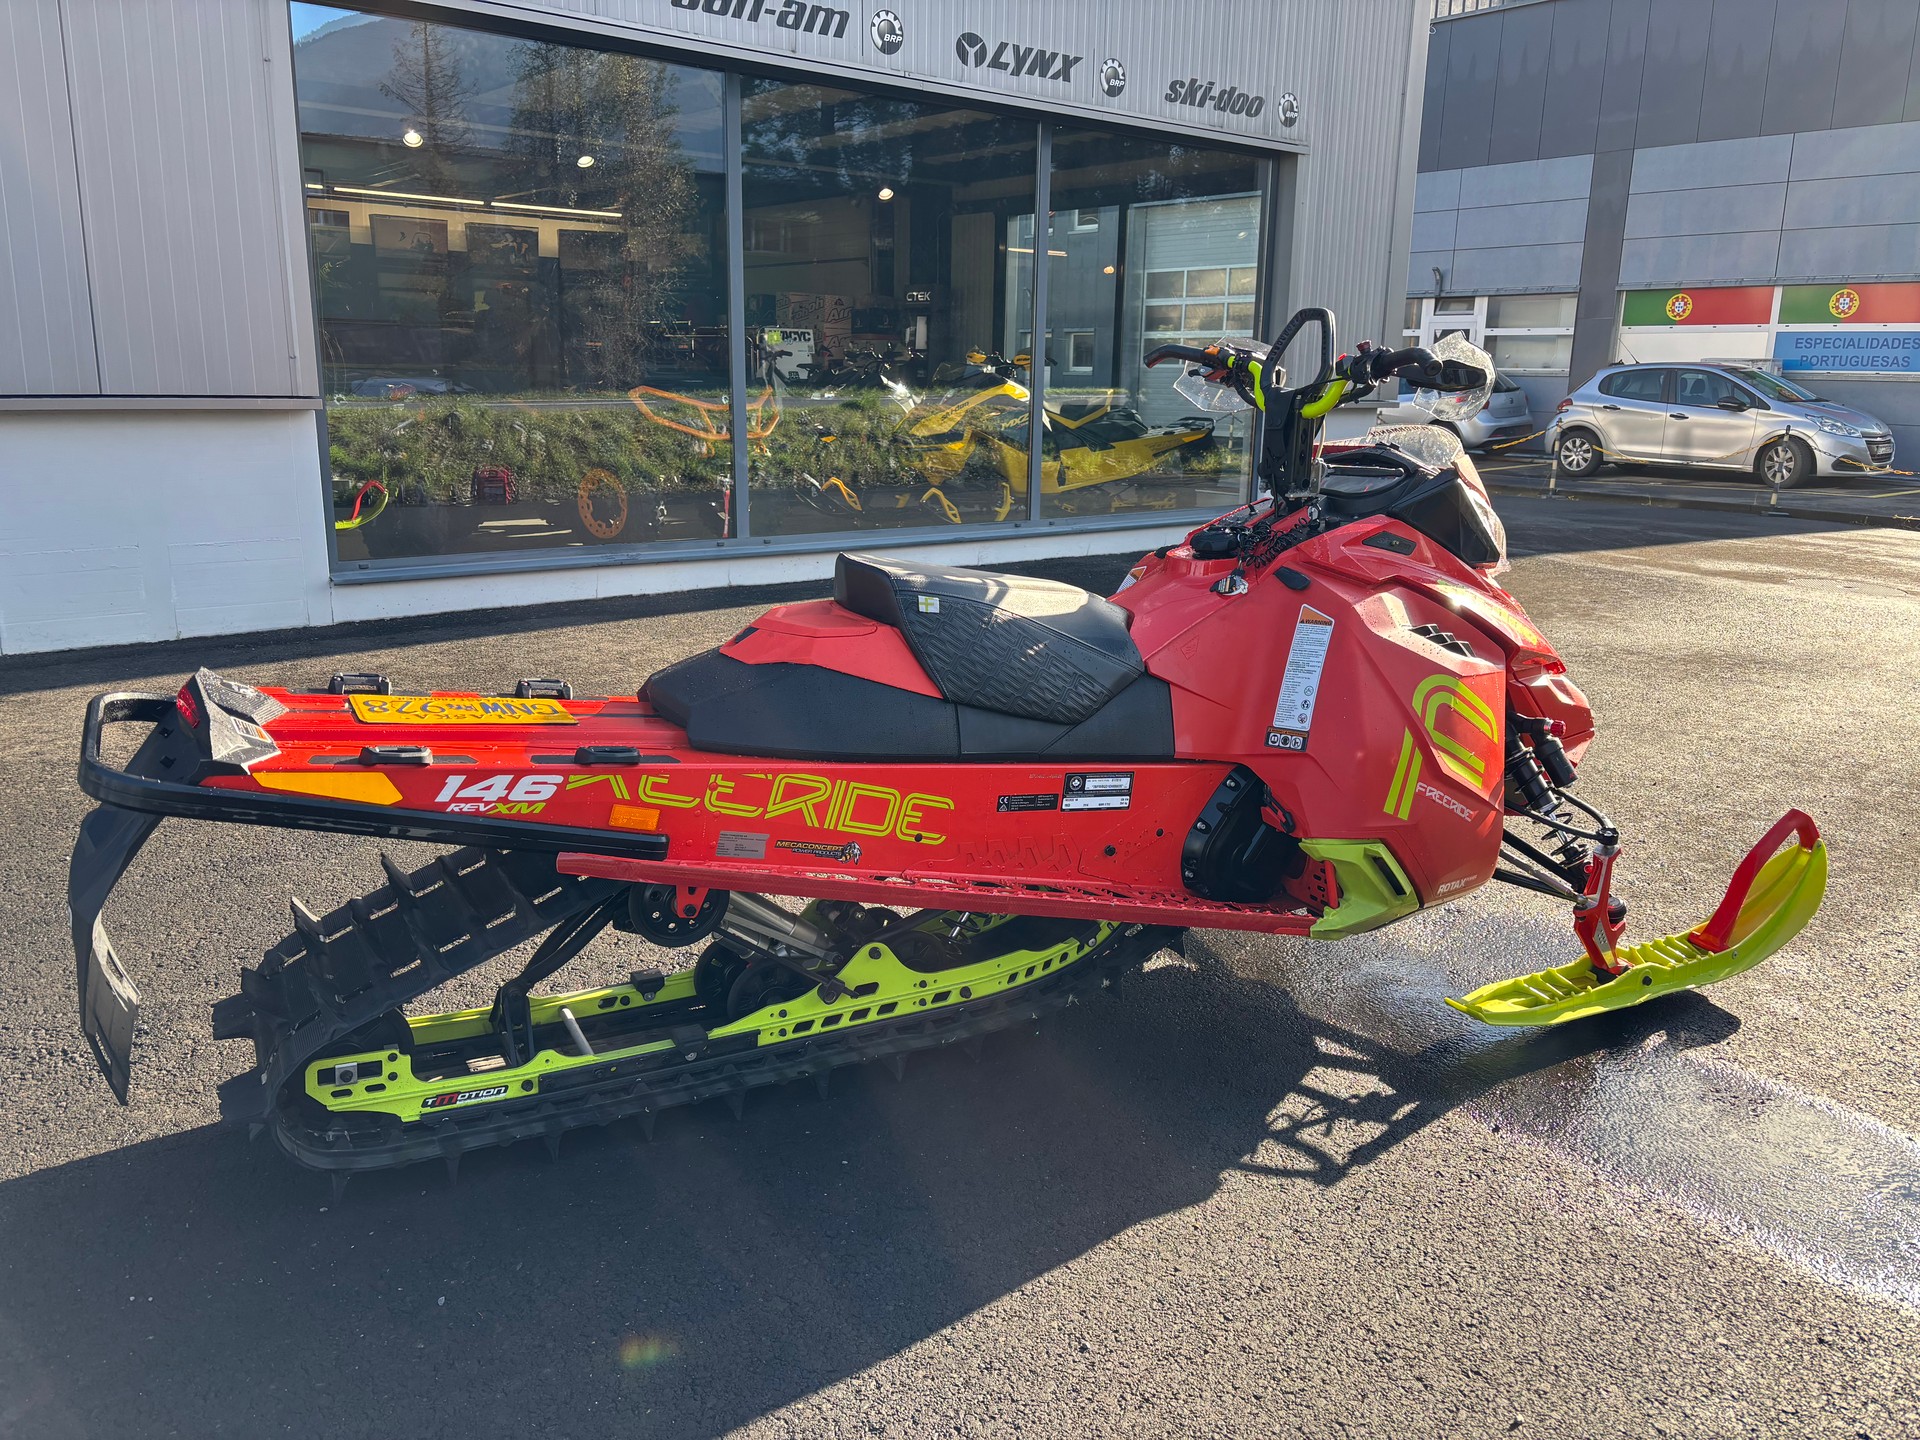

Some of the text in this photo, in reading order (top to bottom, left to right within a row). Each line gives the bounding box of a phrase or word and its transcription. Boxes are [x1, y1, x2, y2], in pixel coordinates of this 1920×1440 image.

[883, 33, 903, 44] BRP
[987, 40, 1083, 84] LYNX
[1109, 79, 1125, 89] BRP
[1164, 77, 1265, 119] ski-doo
[1285, 111, 1299, 120] BRP
[906, 290, 931, 302] CTEK
[1795, 337, 1920, 351] ESPECIALIDADES
[1800, 355, 1911, 368] PORTUGUESAS
[434, 774, 564, 802] 146
[1415, 781, 1476, 823] FREERIDE
[776, 841, 844, 852] MECACONCEPT
[1436, 877, 1467, 896] ROTAX
